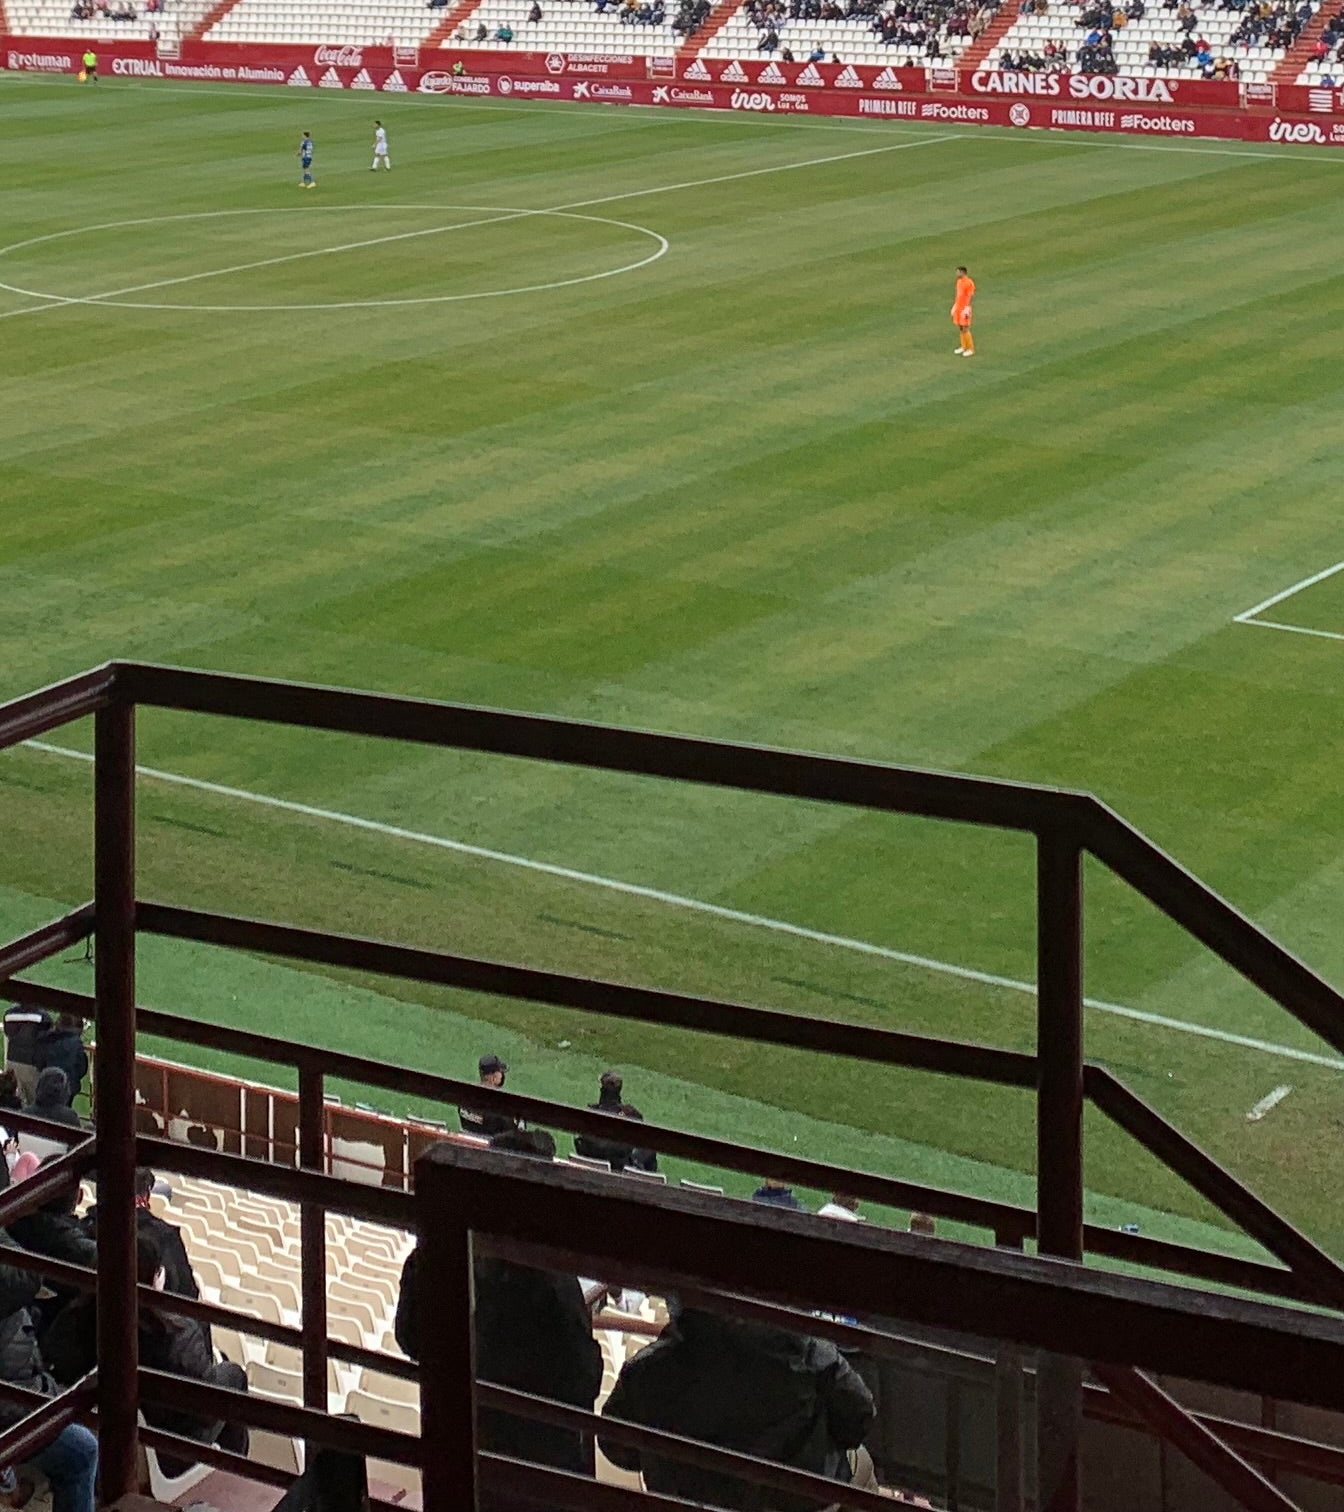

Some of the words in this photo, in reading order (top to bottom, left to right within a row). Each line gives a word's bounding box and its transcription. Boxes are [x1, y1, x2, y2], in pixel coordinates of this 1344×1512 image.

[222, 68, 236, 79] en
[237, 66, 285, 82] Aluminio
[971, 71, 1061, 96] CARNES
[1068, 75, 1172, 103] SORIA
[932, 102, 989, 120] Footters
[1133, 114, 1195, 133] Footters
